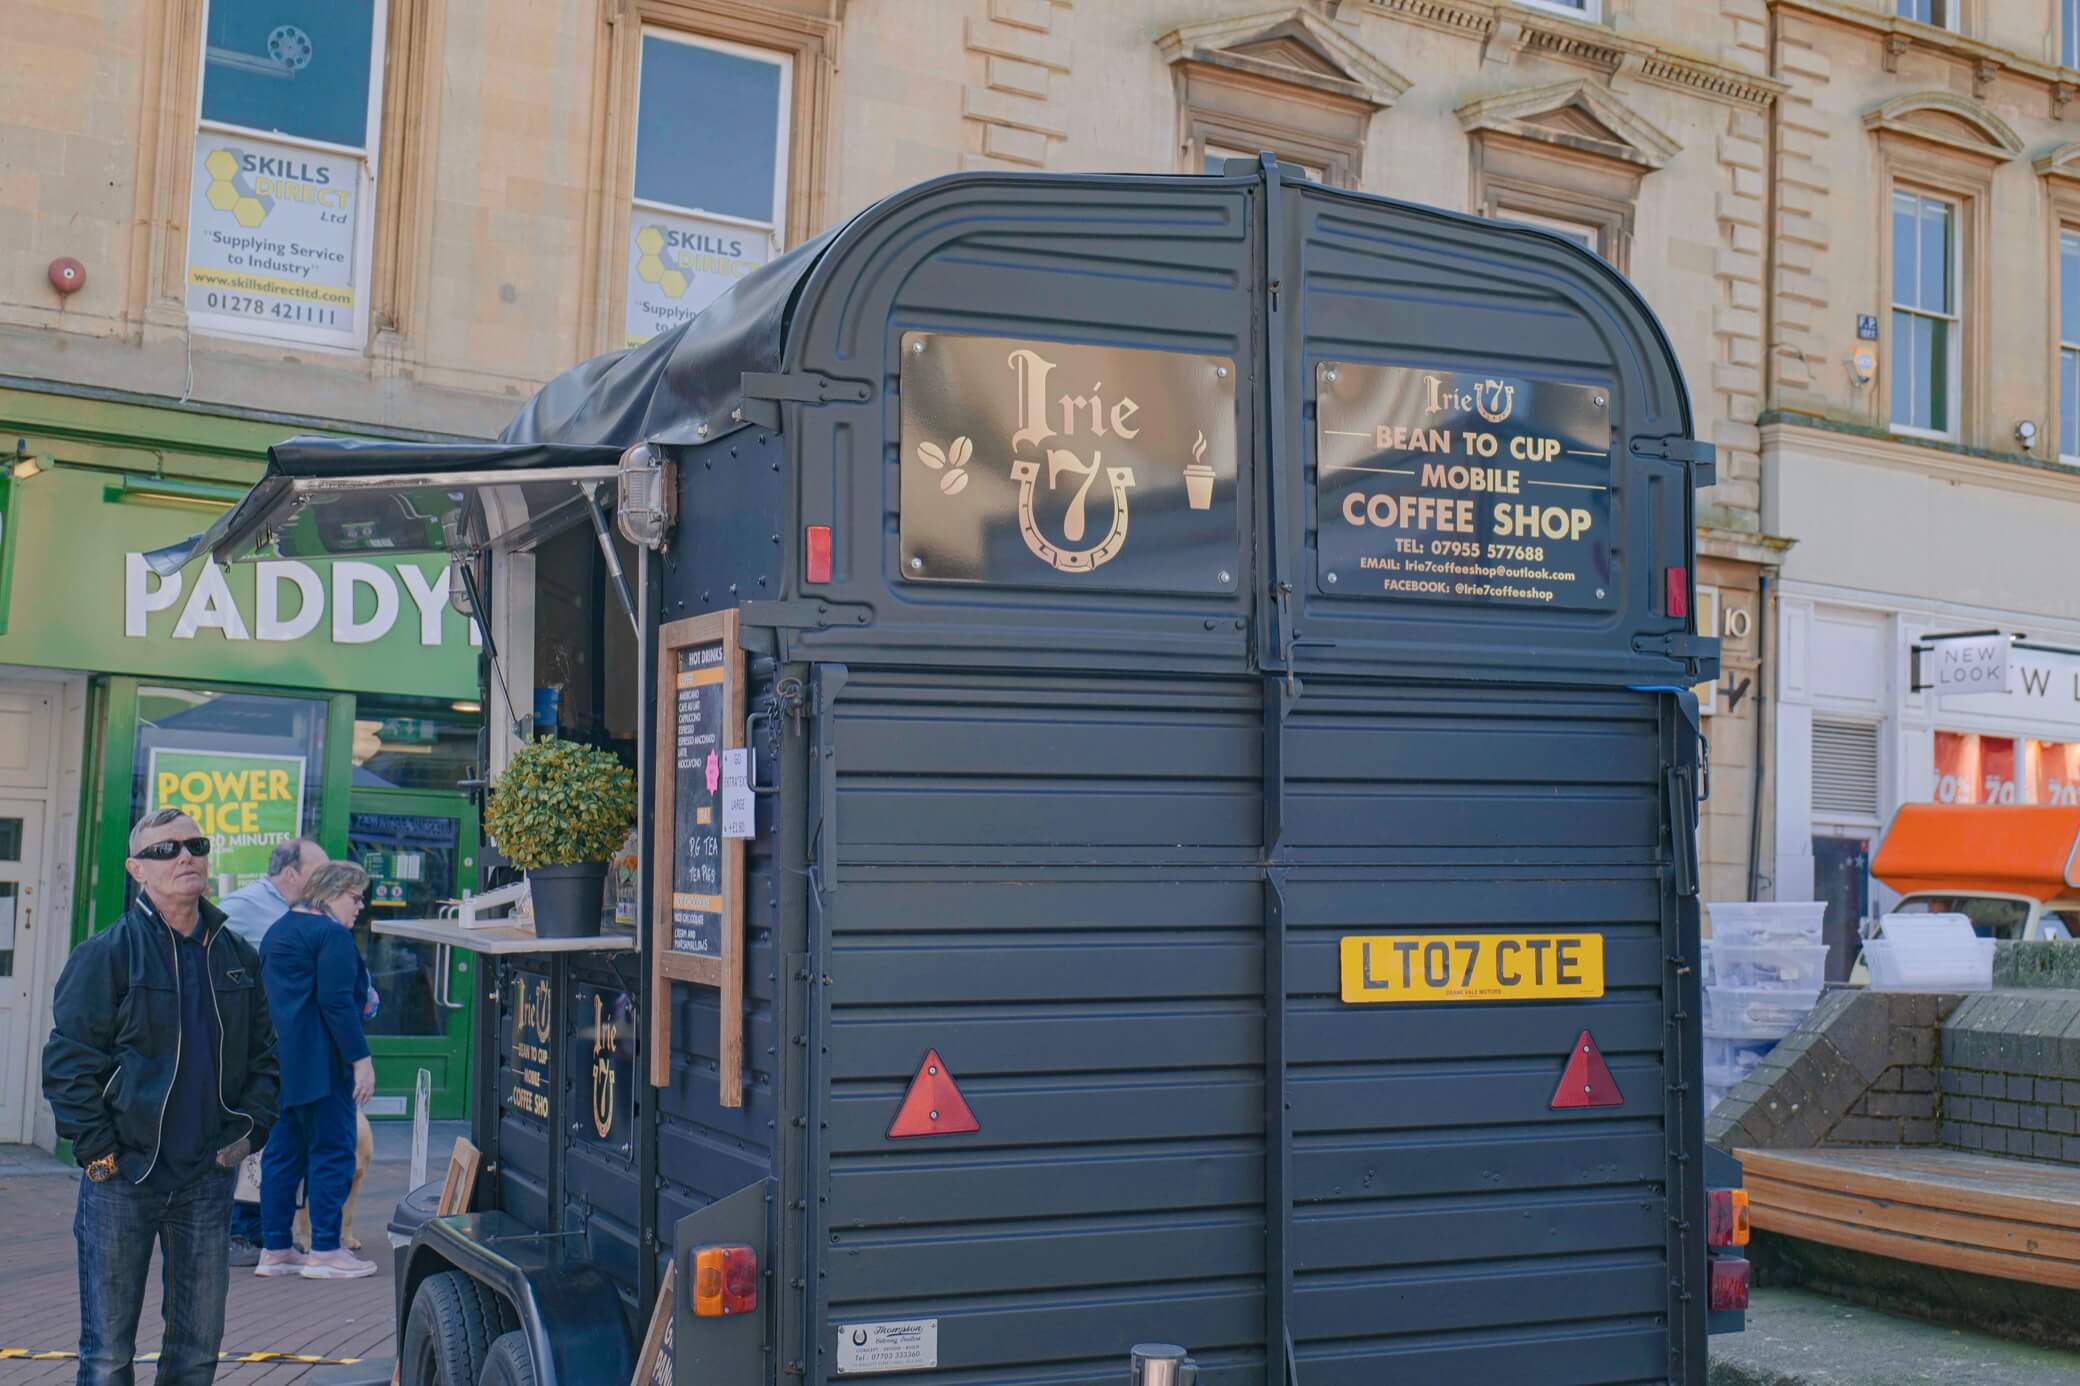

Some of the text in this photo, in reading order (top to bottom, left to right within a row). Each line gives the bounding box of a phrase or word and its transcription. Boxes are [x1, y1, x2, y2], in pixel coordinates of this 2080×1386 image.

[242, 154, 330, 184] SKILLS
[255, 176, 352, 209] DIRECT
[320, 211, 348, 225] Ltd
[290, 242, 344, 263] Service
[666, 230, 742, 257] SKILLS
[228, 253, 243, 265] to
[193, 271, 351, 304] www.skillsdirectltd.com
[207, 292, 335, 325] 01278 421111
[1008, 349, 1140, 455] Irie
[1423, 375, 1472, 415] Irie
[1376, 425, 1561, 462] BEAN TO CUP
[1421, 464, 1520, 494] MOBILE
[1047, 449, 1101, 542] 7
[1342, 492, 1592, 541] COFFEE SHOP
[1395, 538, 1544, 562] TEL: 07955 577688
[1360, 557, 1575, 581] EMAIL: Irie7coffeeshop@outlook.com
[1384, 579, 1553, 601] FACEBOOK: @Irie7coffeeshop
[689, 651, 700, 665] HOT
[702, 646, 722, 664] DRINKS
[1945, 648, 1996, 663] NEW
[1940, 665, 2000, 684] LOOK
[158, 770, 292, 803] POWER
[159, 801, 260, 834] RICE
[229, 832, 290, 847] MINUTES
[1496, 939, 1582, 985] CTE
[593, 994, 617, 1056] Irie
[534, 1094, 548, 1118] SHO
